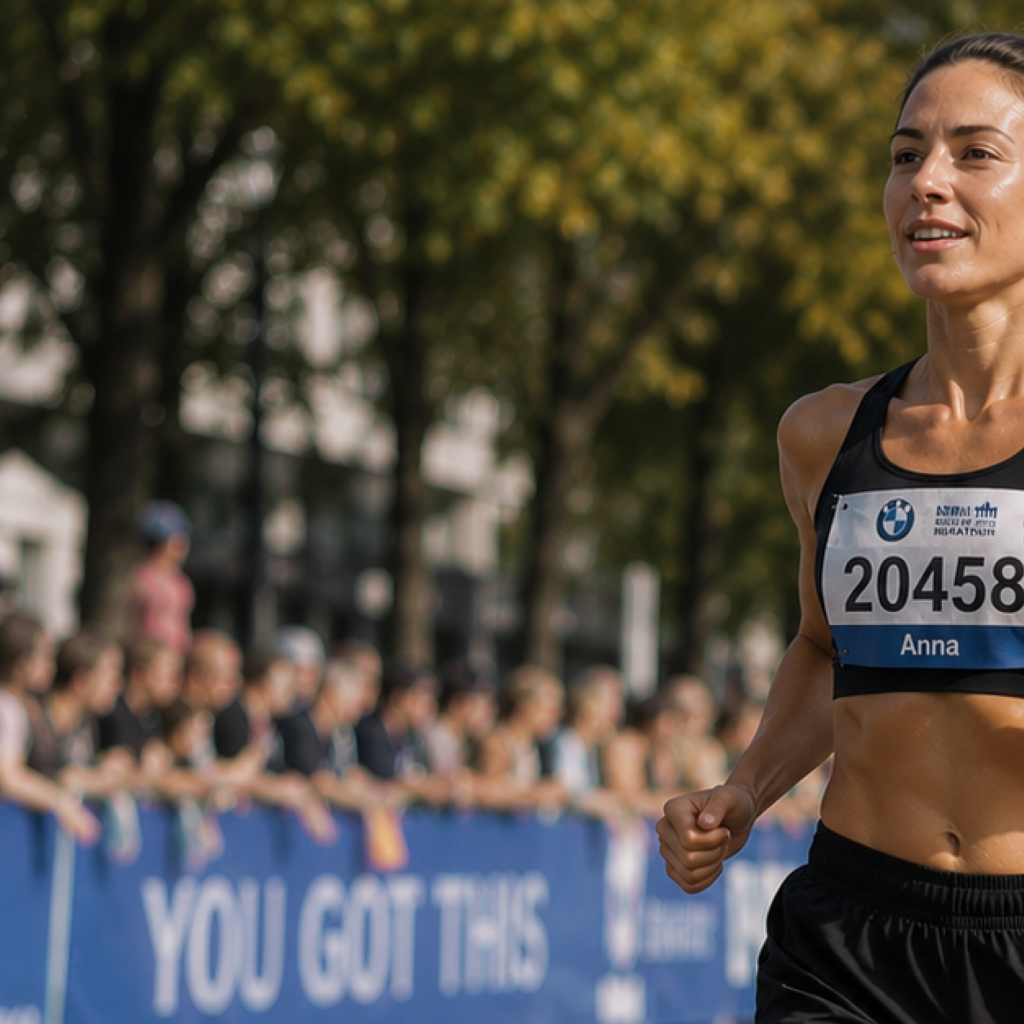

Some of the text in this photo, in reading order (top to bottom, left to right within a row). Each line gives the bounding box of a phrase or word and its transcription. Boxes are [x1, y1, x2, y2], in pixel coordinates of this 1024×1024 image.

[900, 633, 960, 656] Anna
[141, 874, 287, 1016] YOU
[299, 872, 426, 1007] GOT
[432, 871, 550, 996] THIS
